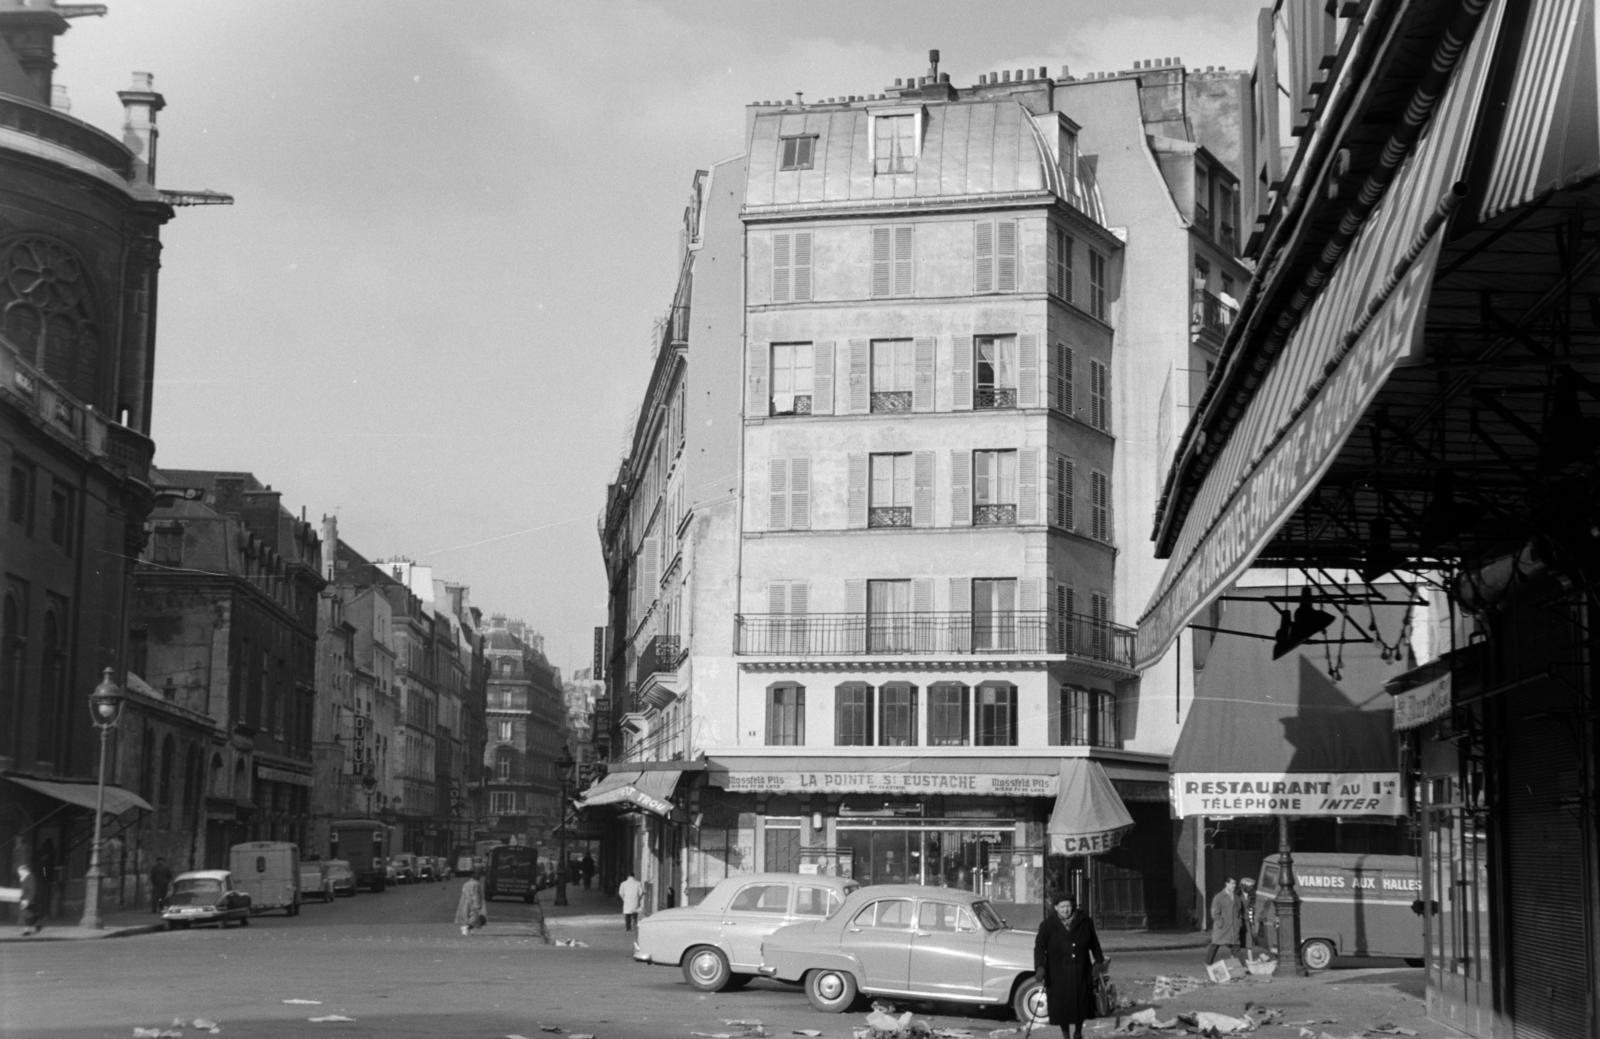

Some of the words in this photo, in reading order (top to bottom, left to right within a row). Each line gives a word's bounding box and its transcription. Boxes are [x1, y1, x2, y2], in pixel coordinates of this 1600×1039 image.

[801, 774, 818, 787] LA
[825, 774, 874, 786] POINTE
[903, 775, 976, 789] EUSTACHE
[1185, 781, 1330, 795] RESTAURANT
[1340, 784, 1360, 795] AU
[637, 792, 668, 811] TROU
[1202, 797, 1301, 810] TÉLÉPHONE
[1319, 798, 1380, 810] INTER
[1297, 875, 1345, 888] VIANDES
[1351, 877, 1376, 889] AUX
[1383, 878, 1422, 890] HALLES
